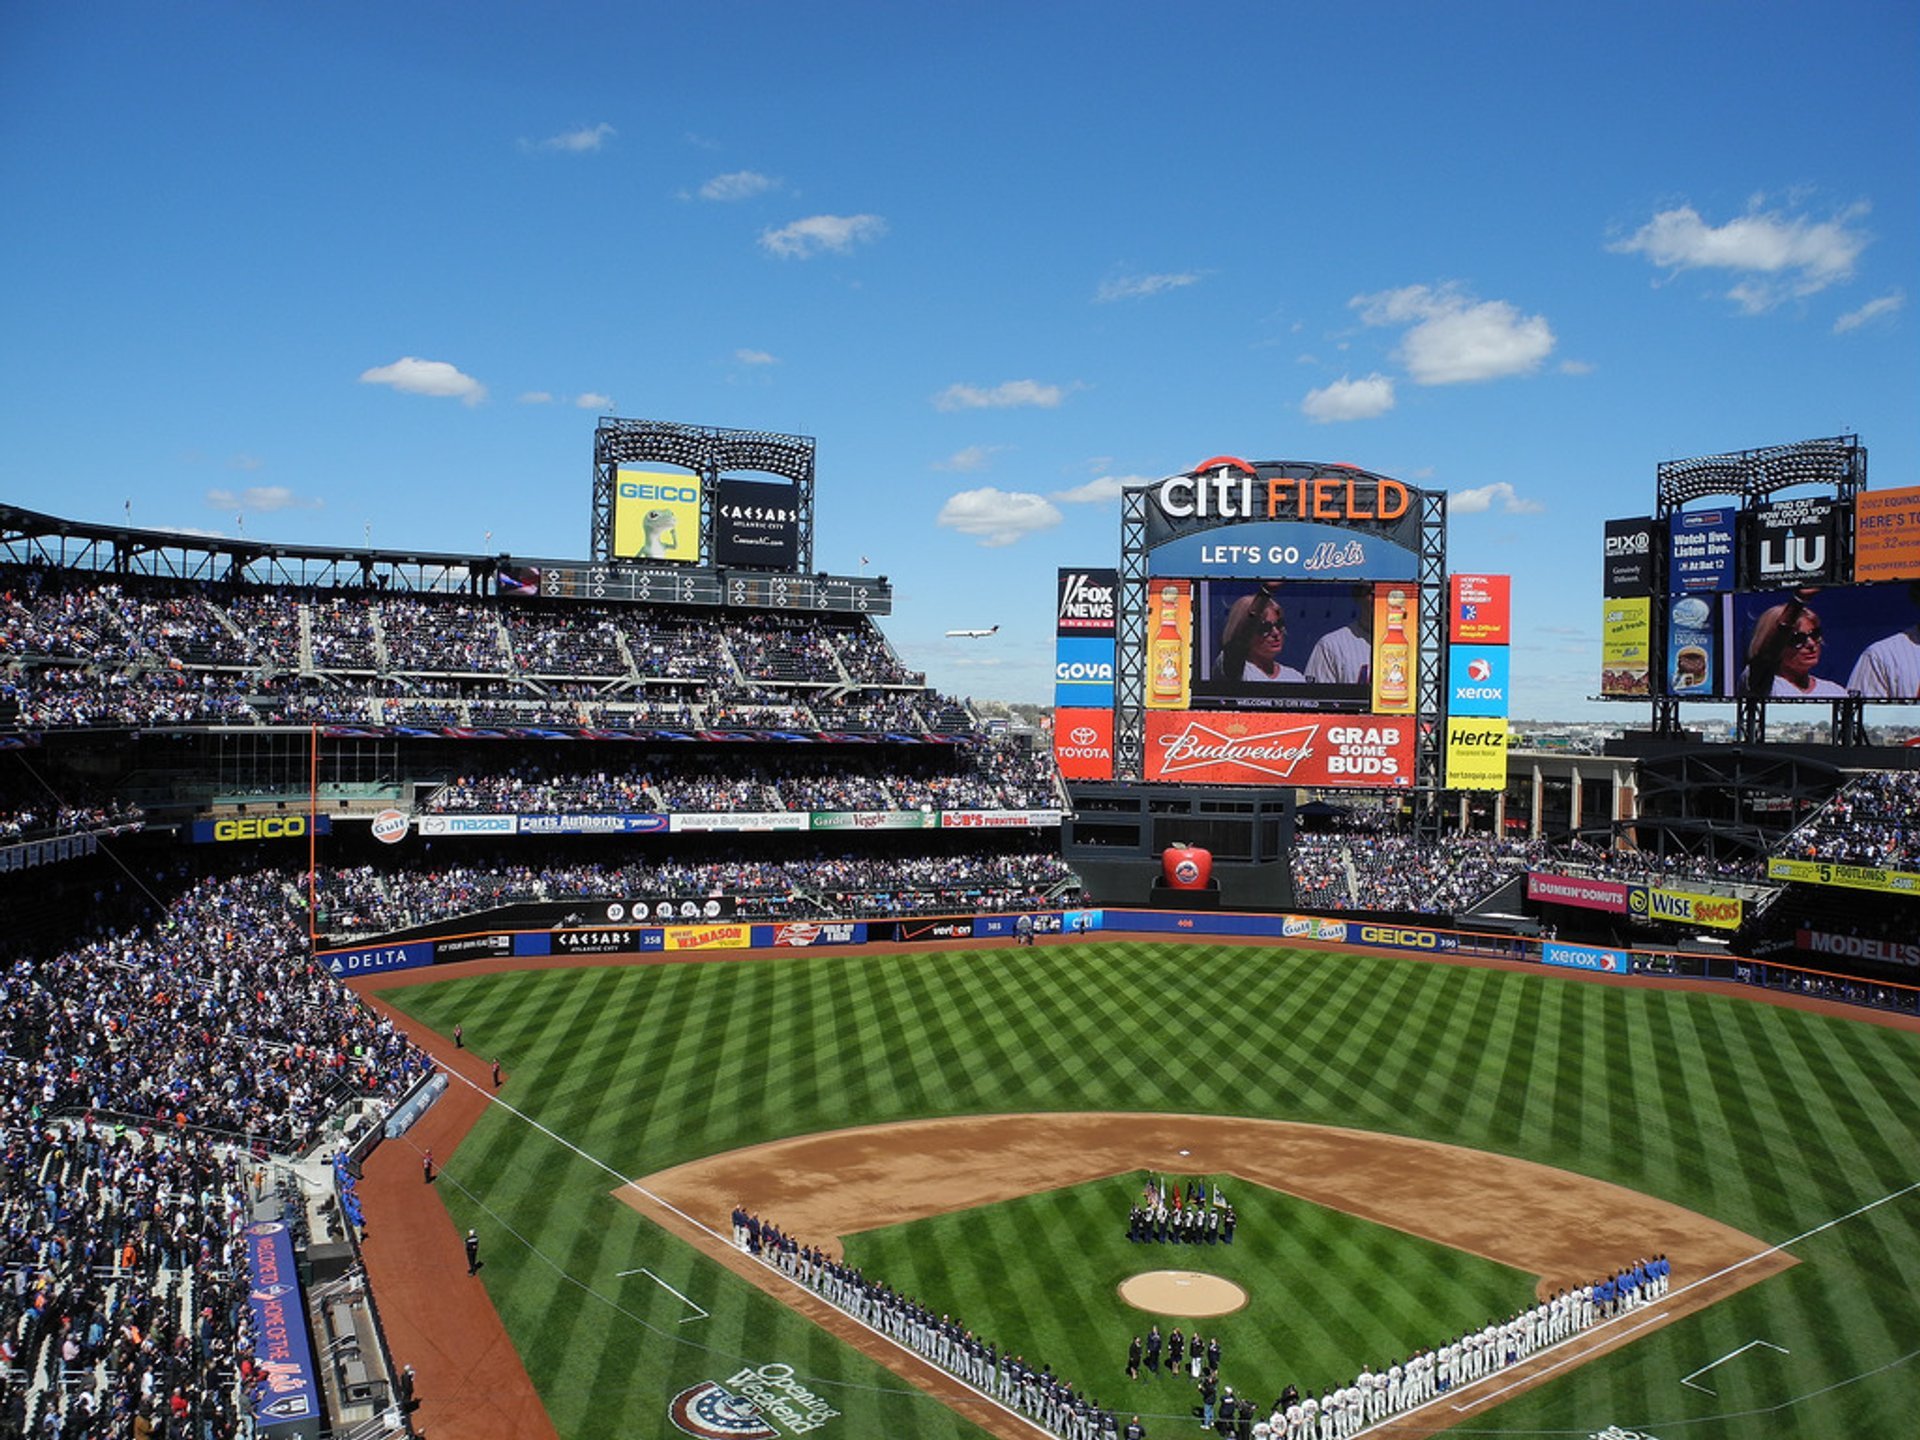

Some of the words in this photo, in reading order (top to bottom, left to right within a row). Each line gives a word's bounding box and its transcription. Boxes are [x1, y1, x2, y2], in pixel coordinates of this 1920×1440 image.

[619, 484, 697, 503] GEICO
[1268, 478, 1409, 519] FIELD
[1795, 498, 1815, 508] OUT
[720, 505, 797, 522] CAESARS
[1758, 511, 1780, 520] HOW
[1782, 507, 1809, 518] GOOD
[1811, 505, 1832, 514] YOU
[1765, 517, 1799, 528] REALLY
[1859, 514, 1905, 529] HERE'S
[1674, 533, 1706, 546] Watch
[1708, 531, 1732, 543] live.
[1201, 545, 1262, 564] LET'S
[1268, 546, 1299, 564] GO
[1303, 540, 1366, 571] Mets
[1674, 545, 1706, 558] Listen
[1708, 543, 1730, 555] live.
[1760, 528, 1826, 574] LIU
[1077, 586, 1114, 603] FOX
[1067, 603, 1114, 618] NEWS
[1059, 619, 1115, 628] channel
[1057, 662, 1112, 680] GOYA
[1455, 687, 1502, 699] xerox
[1274, 699, 1285, 707] TO
[1300, 700, 1320, 708] FIELD
[1327, 727, 1400, 745] GRAB
[1450, 729, 1503, 746] Hertz
[1057, 747, 1110, 759] TOYOTA
[1158, 735, 1314, 761] Budweiser
[1339, 746, 1388, 757] SOME
[1327, 756, 1398, 775] BUDS
[374, 818, 405, 836] Gulf
[450, 818, 511, 831] mazda
[520, 817, 559, 830] Parts
[560, 815, 626, 829] Authority
[680, 816, 719, 826] Alliance
[720, 816, 759, 827] Building
[760, 815, 800, 825] Services
[852, 811, 886, 828] Veggie
[943, 812, 983, 827] BOB'S
[984, 816, 1028, 826] FURNITURE
[213, 816, 306, 842] GEICO
[1835, 867, 1887, 882] FOOTLONGS
[1581, 890, 1624, 904] DONUTS
[1651, 892, 1691, 917] WISE
[1693, 900, 1739, 921] SNACKS
[699, 927, 742, 944] MASON
[933, 925, 971, 937] verizon
[1284, 920, 1311, 935] Gulf
[1318, 924, 1345, 938] Gulf
[558, 931, 631, 945] CAESARS
[643, 935, 662, 945] 358
[1361, 926, 1436, 948] GEICO
[1811, 931, 1920, 967] MODELL'S
[348, 949, 407, 969] DELTA
[1549, 948, 1597, 967] xerox
[264, 1300, 285, 1327] HOME
[757, 1362, 842, 1423] Opening
[725, 1367, 825, 1435] Weekend
